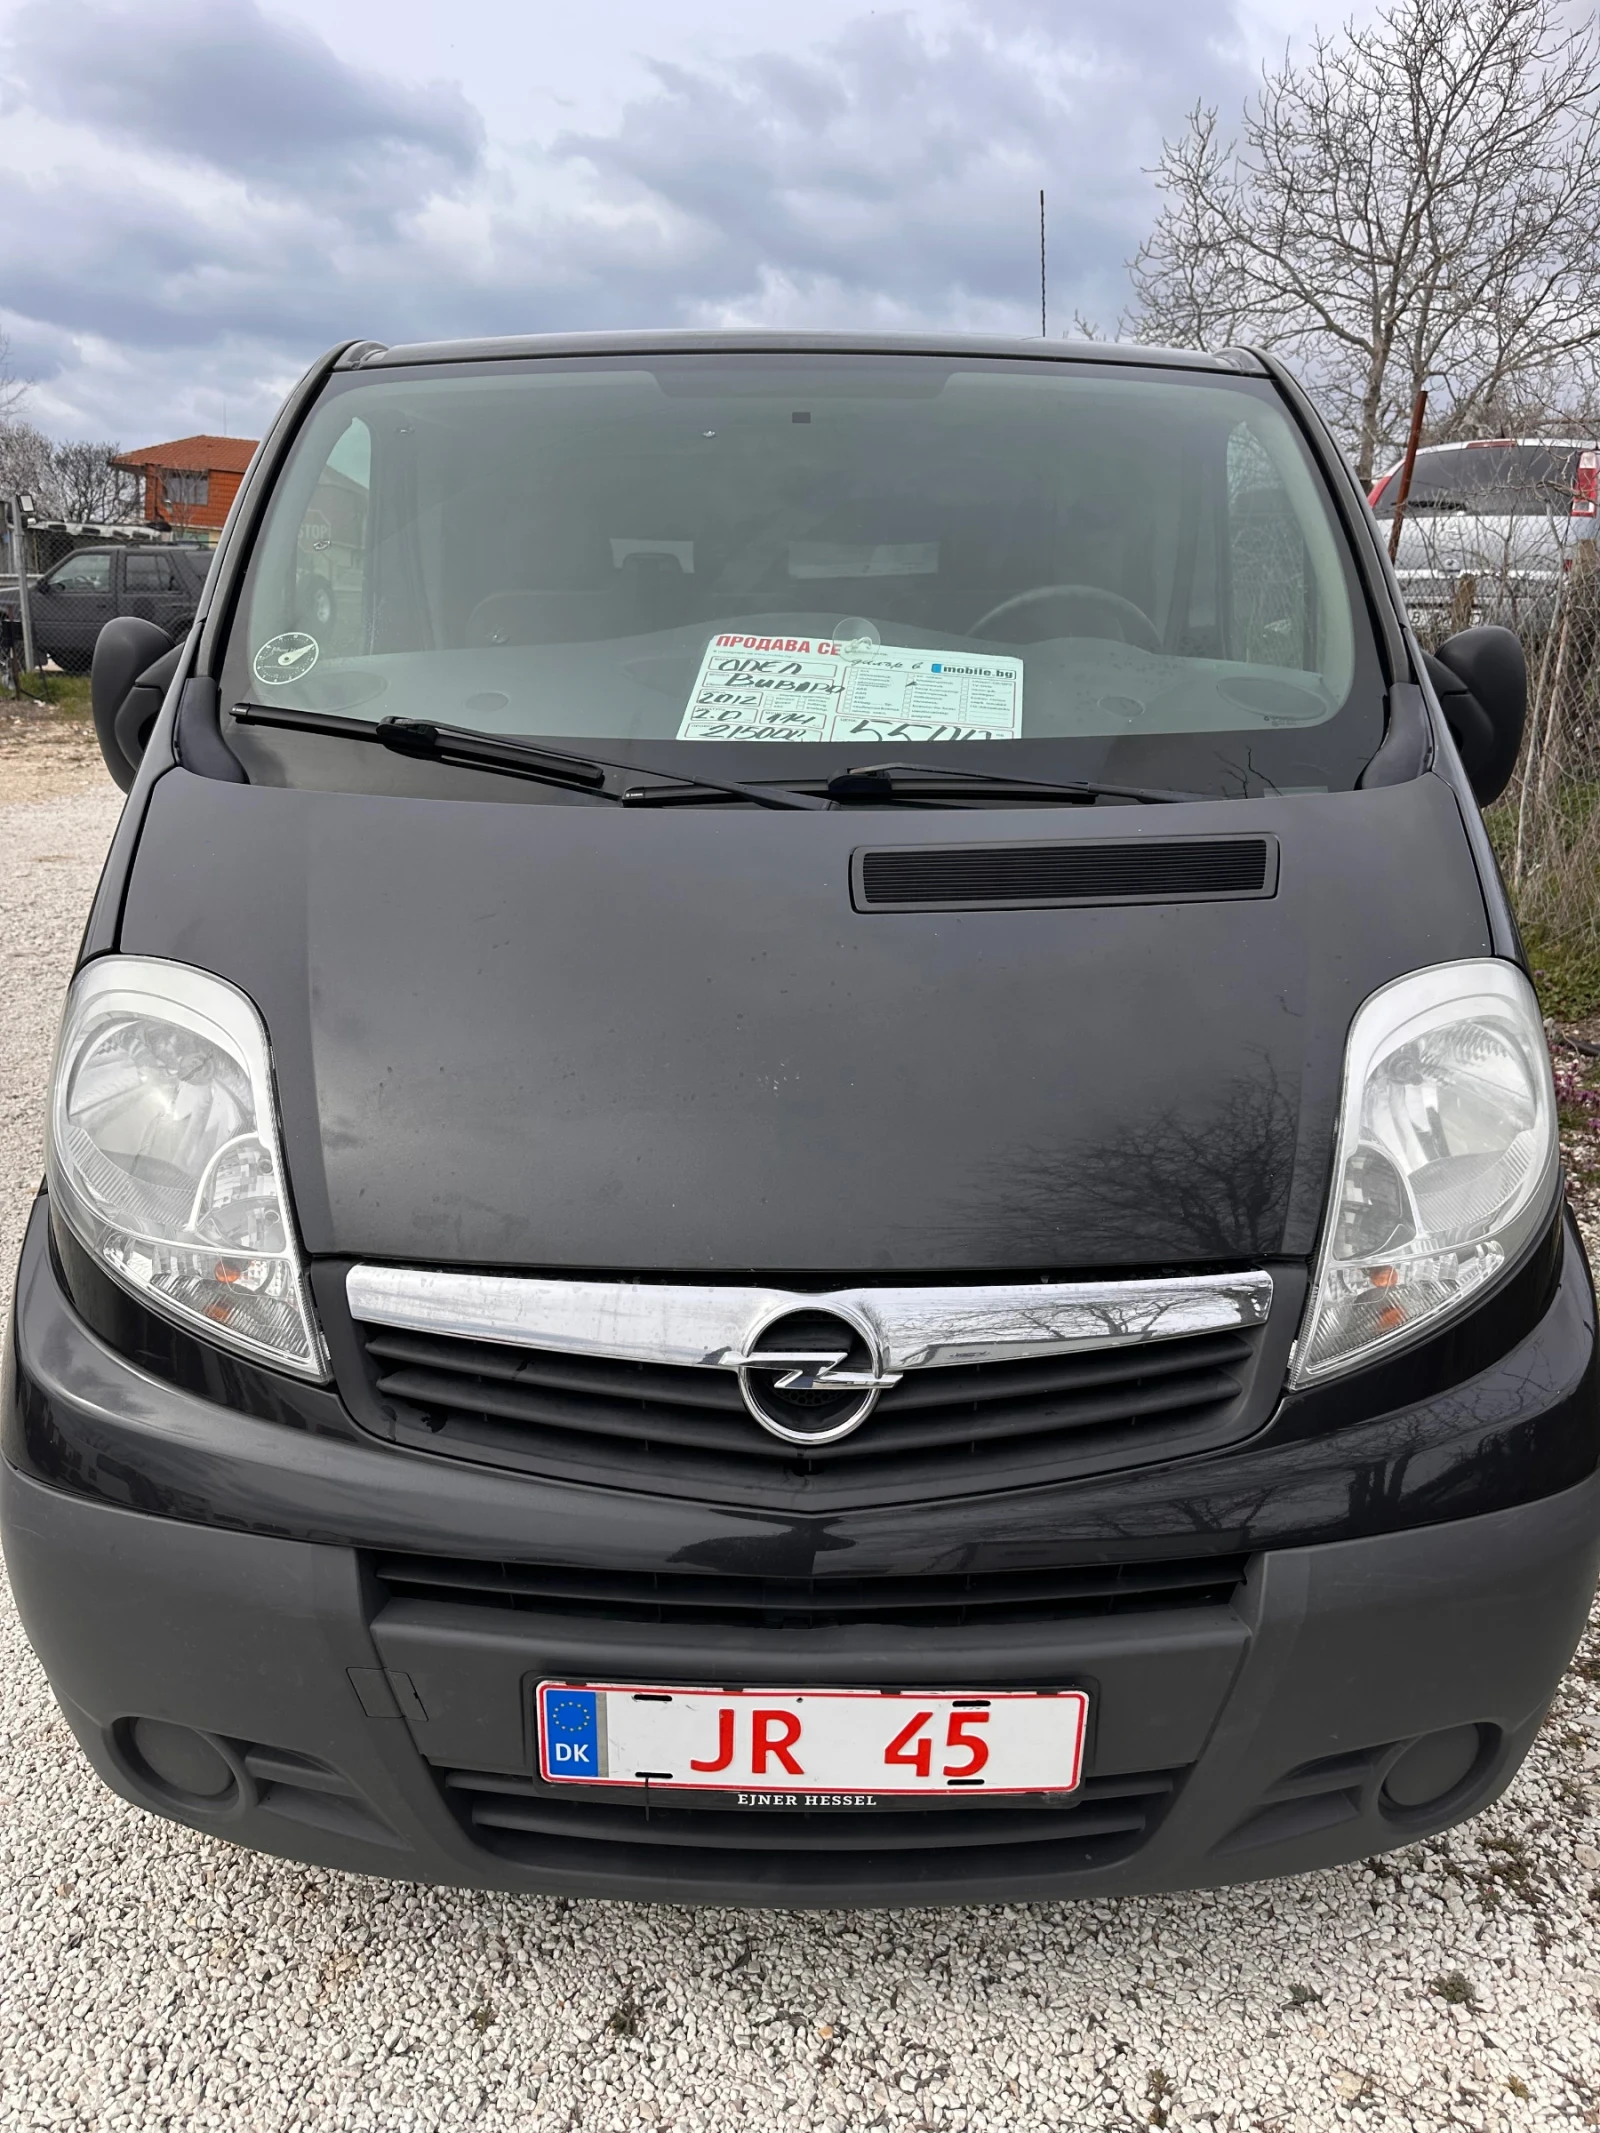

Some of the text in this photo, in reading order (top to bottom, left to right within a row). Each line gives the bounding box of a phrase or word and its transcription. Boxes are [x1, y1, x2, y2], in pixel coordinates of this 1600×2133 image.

[716, 635, 842, 655] ПРОДАВА СЕ
[942, 664, 1014, 679] mobile.bg
[698, 692, 758, 705] 2012
[690, 1708, 990, 1777] JR 45
[555, 1744, 590, 1763] DK
[738, 1793, 877, 1807] EJNER HESSEL
